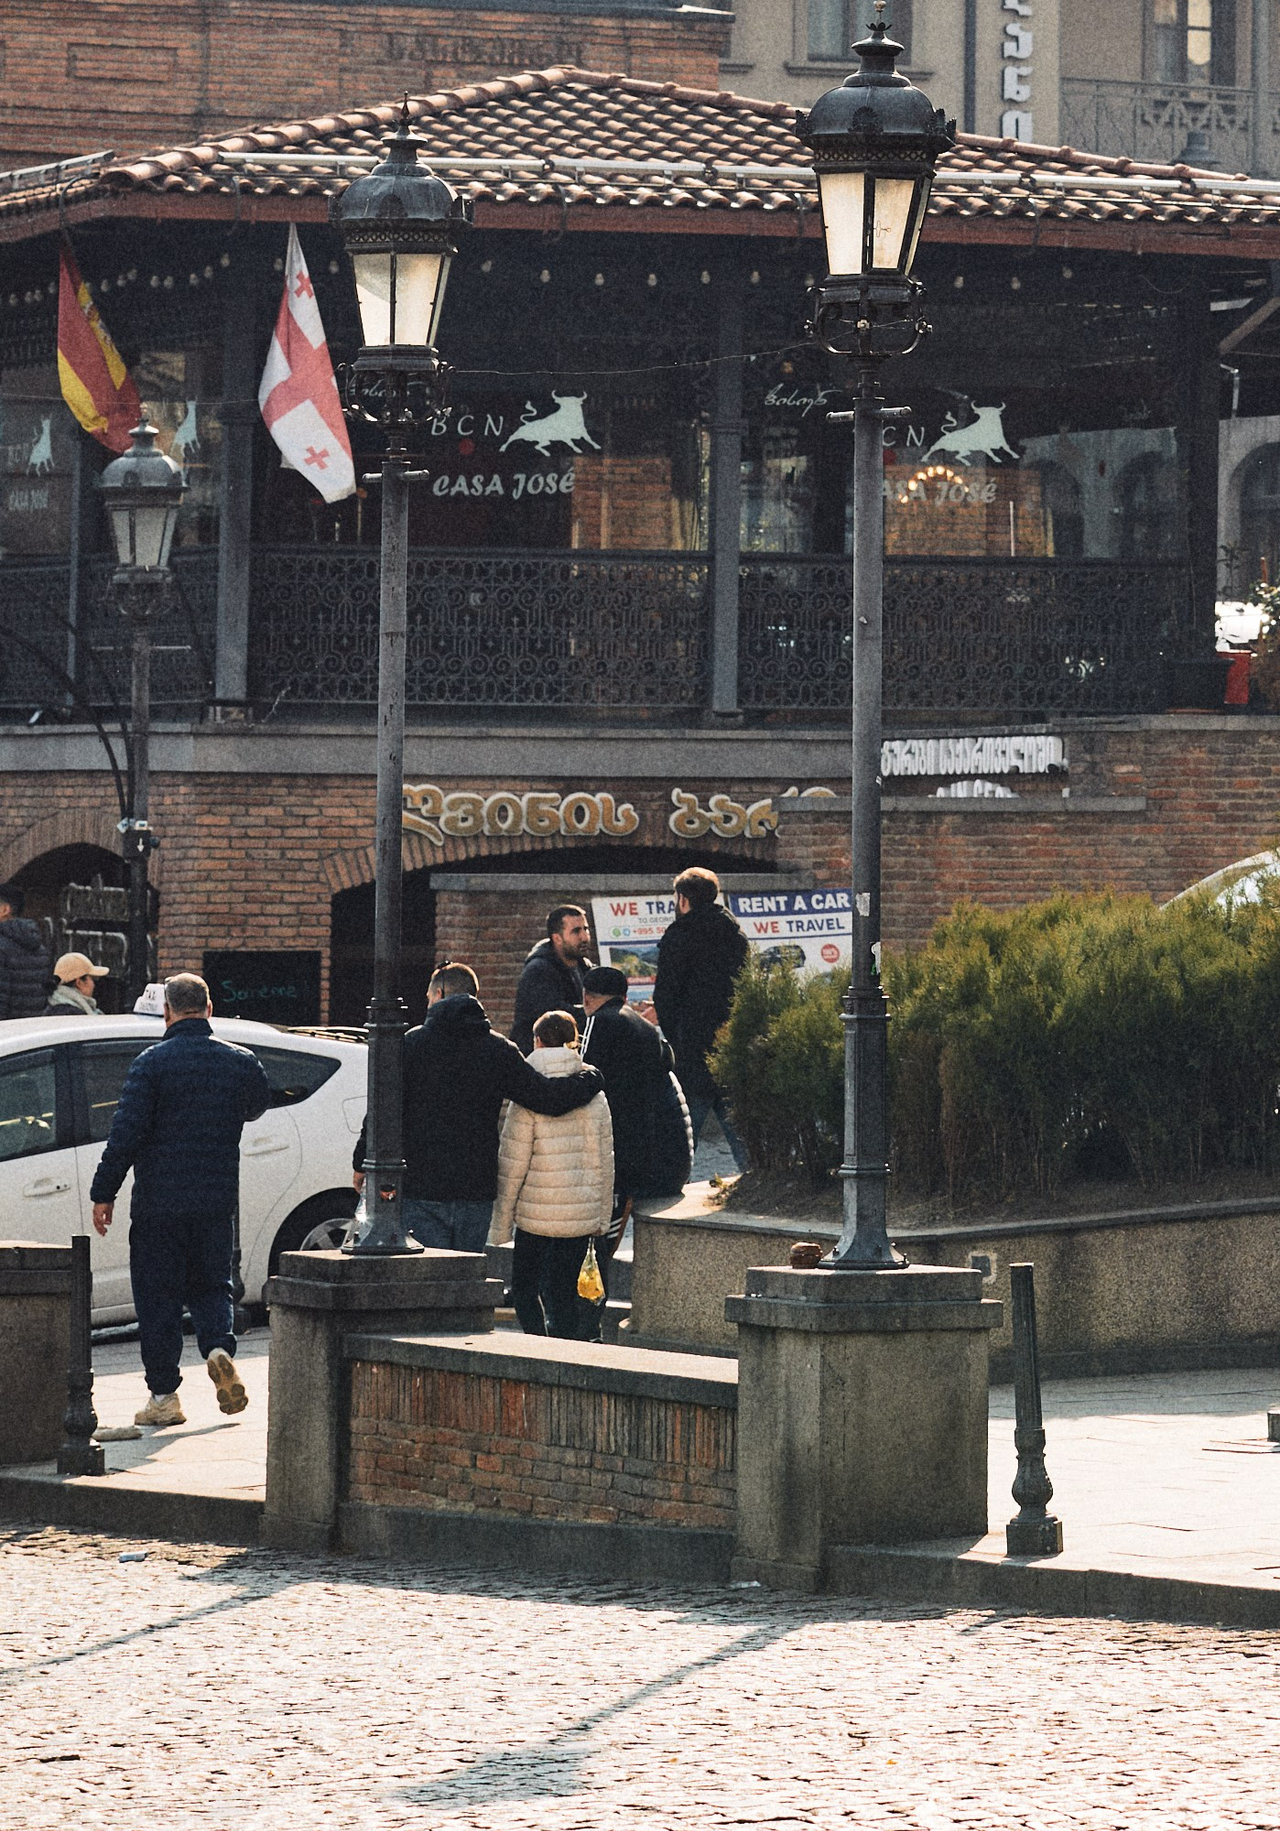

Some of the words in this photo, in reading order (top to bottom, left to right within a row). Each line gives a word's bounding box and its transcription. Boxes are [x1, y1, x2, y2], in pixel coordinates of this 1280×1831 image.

[430, 414, 504, 437] BCN
[881, 425, 925, 447] CN
[433, 474, 504, 497] CASA
[402, 783, 640, 848] ღვინის
[668, 784, 843, 840] ბარ
[610, 901, 639, 917] WE
[738, 896, 788, 913] RENT
[793, 894, 807, 911] A
[810, 892, 851, 910] CAR
[753, 921, 780, 934] WE
[786, 918, 846, 933] TRAVEL
